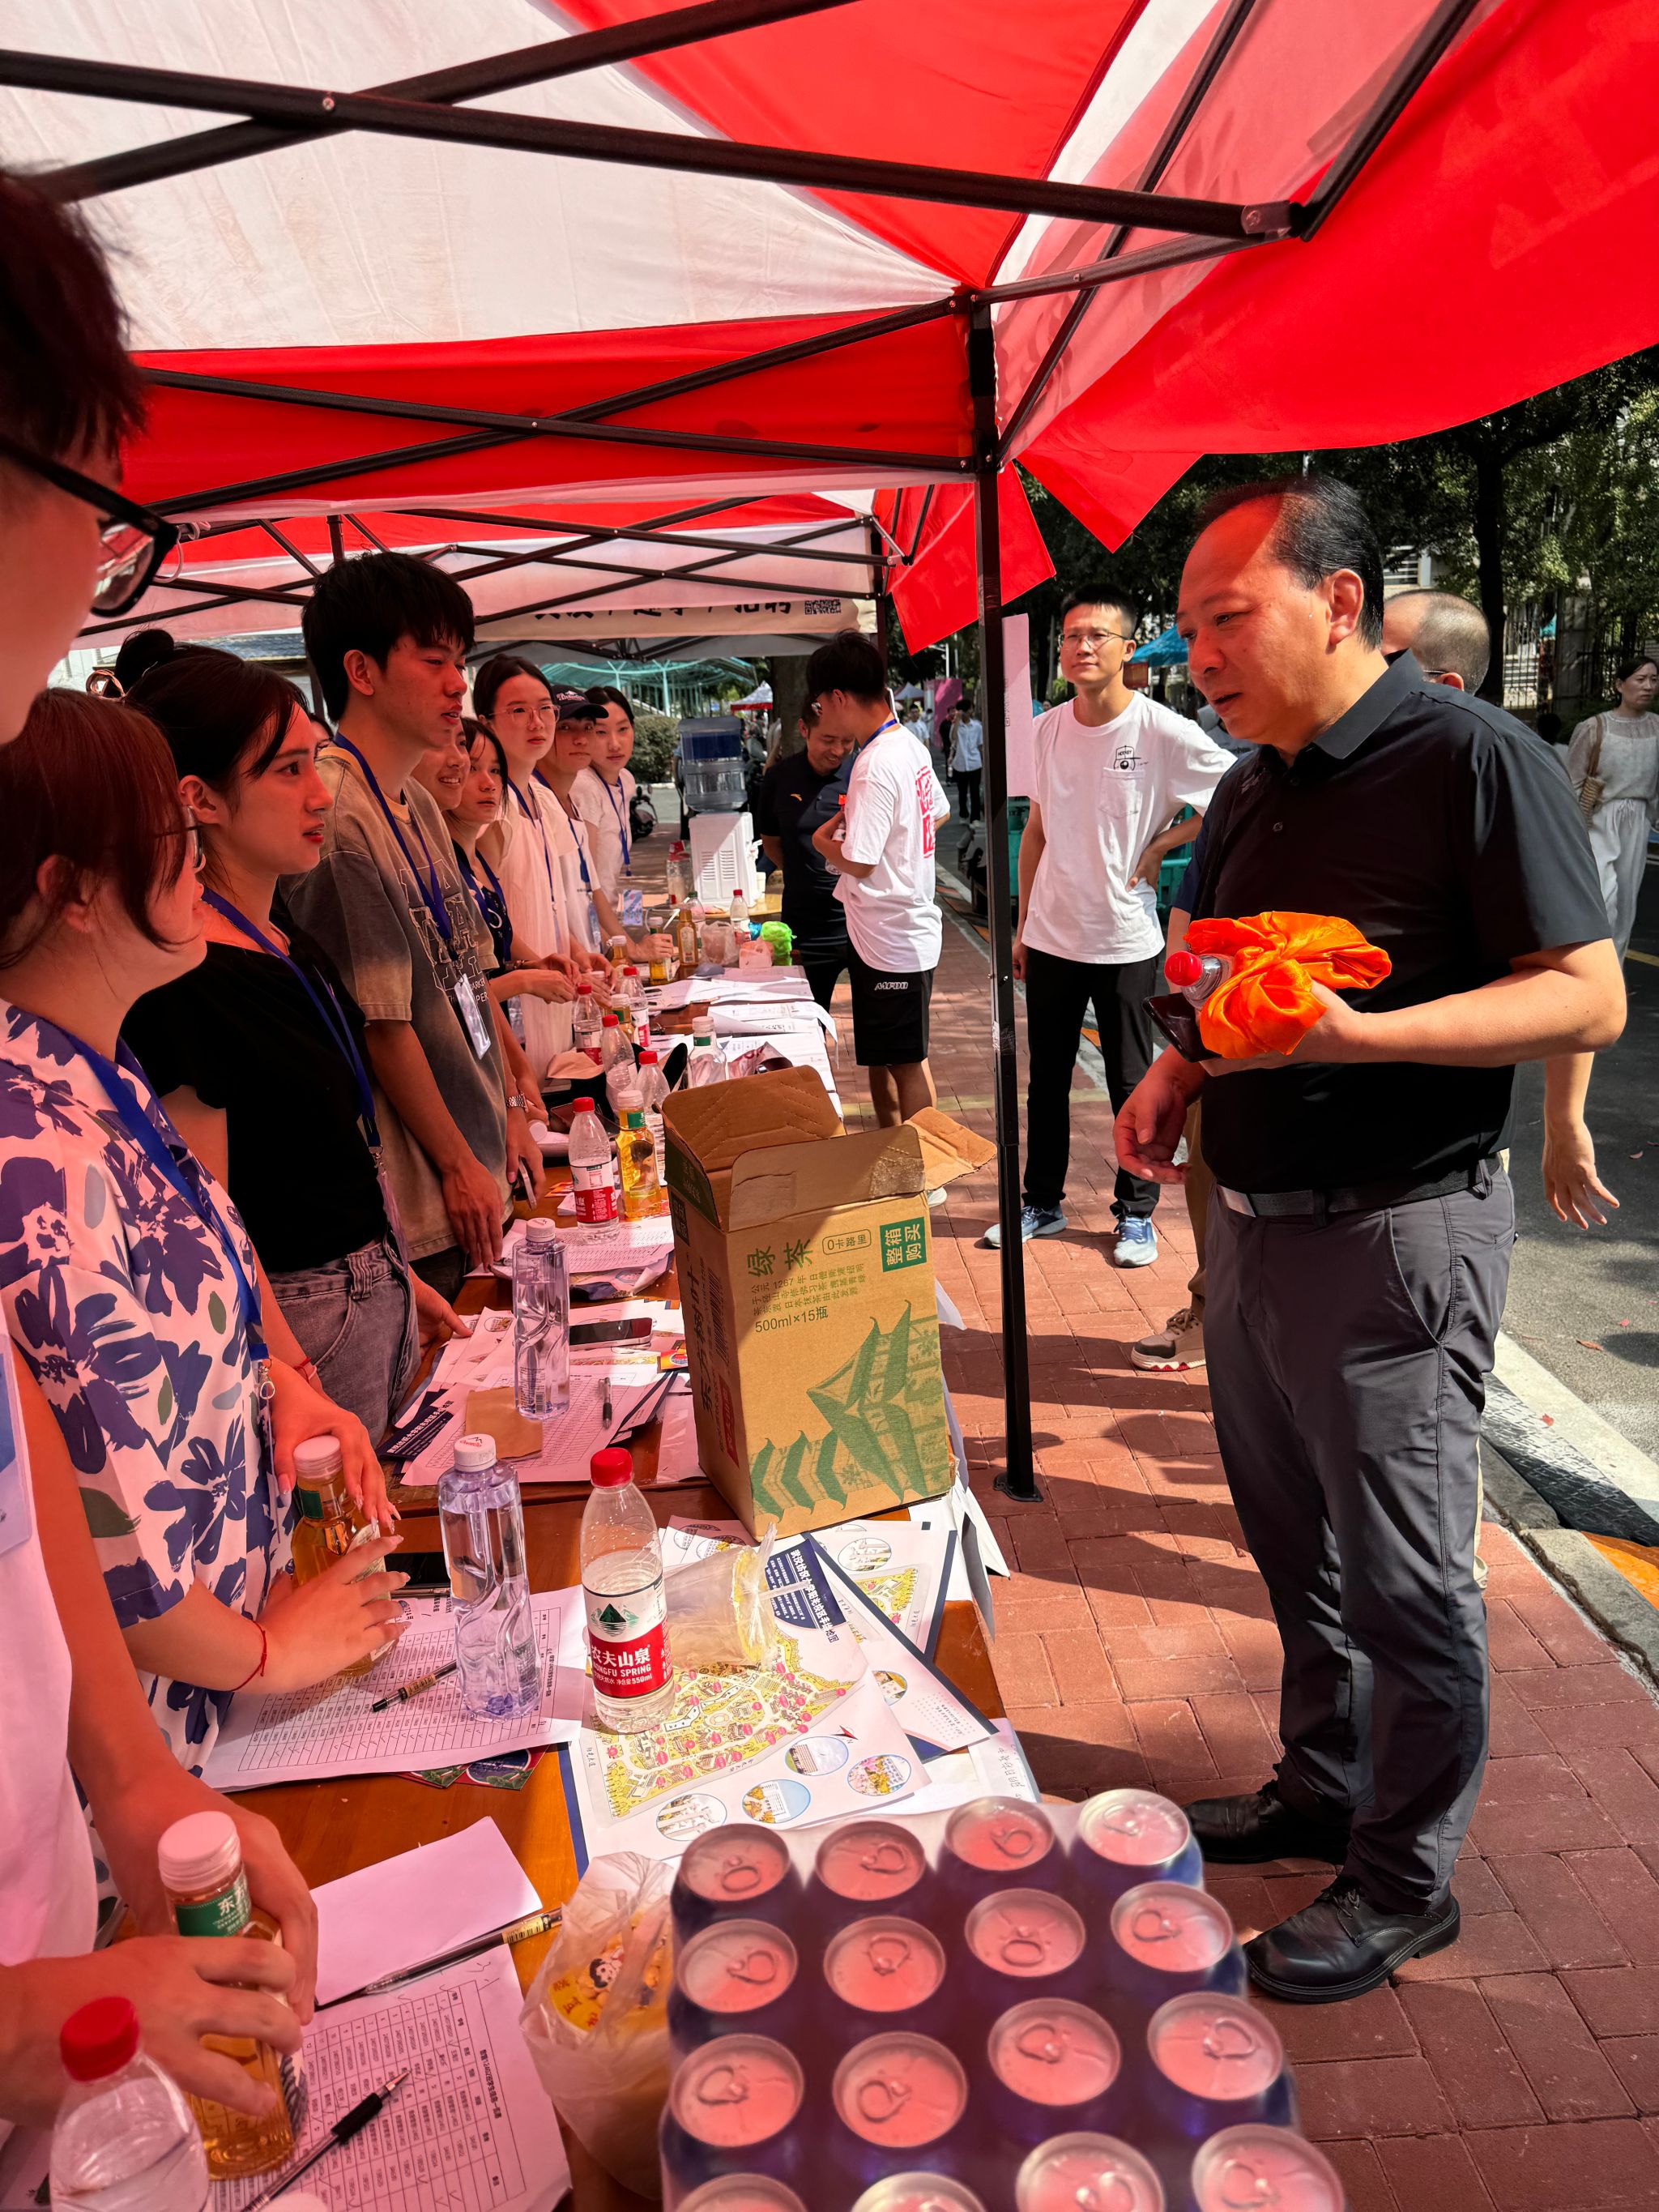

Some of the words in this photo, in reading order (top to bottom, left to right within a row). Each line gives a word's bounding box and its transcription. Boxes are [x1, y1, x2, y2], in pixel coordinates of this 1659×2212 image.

[827, 1234, 868, 1251] 0卡路里
[885, 1228, 903, 1266] 整箱
[904, 1223, 922, 1262] 购买
[746, 1238, 813, 1278] 绿茶
[774, 1278, 794, 1289] 1267
[797, 1275, 806, 1284] 年
[754, 1305, 829, 1333] 500ml×15瓶
[686, 1265, 714, 1415] 东方树叶
[591, 1645, 650, 1668] 农夫山泉
[620, 1663, 651, 1677] SPRING
